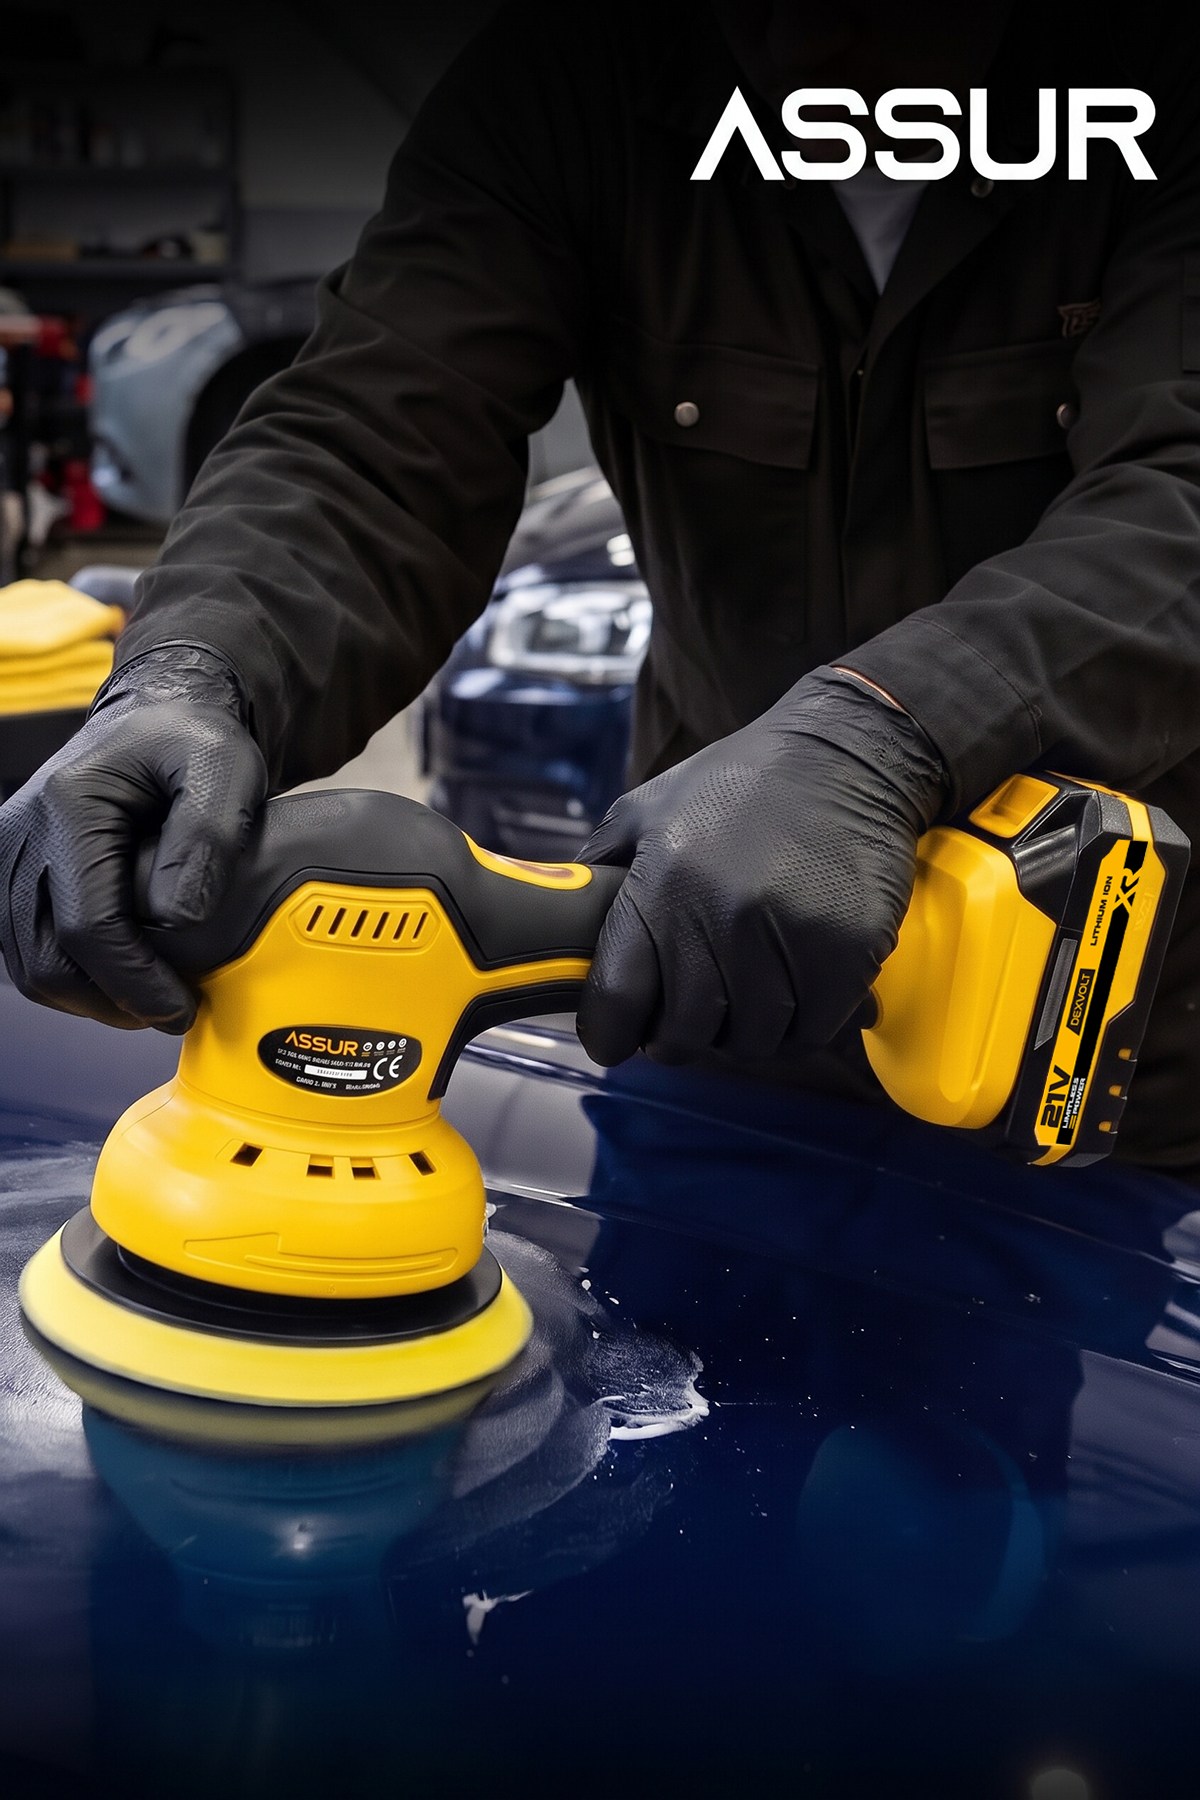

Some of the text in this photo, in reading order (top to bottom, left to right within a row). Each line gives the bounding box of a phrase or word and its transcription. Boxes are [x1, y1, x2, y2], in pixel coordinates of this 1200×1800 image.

[1090, 875, 1113, 946] LITHIUM ION
[1070, 973, 1091, 1026] DEXVOLT
[285, 1030, 358, 1057] ASSUR
[1040, 1064, 1071, 1129] 21V
[1062, 1077, 1080, 1129] LIMITLESS
[1072, 1077, 1086, 1115] POWER
